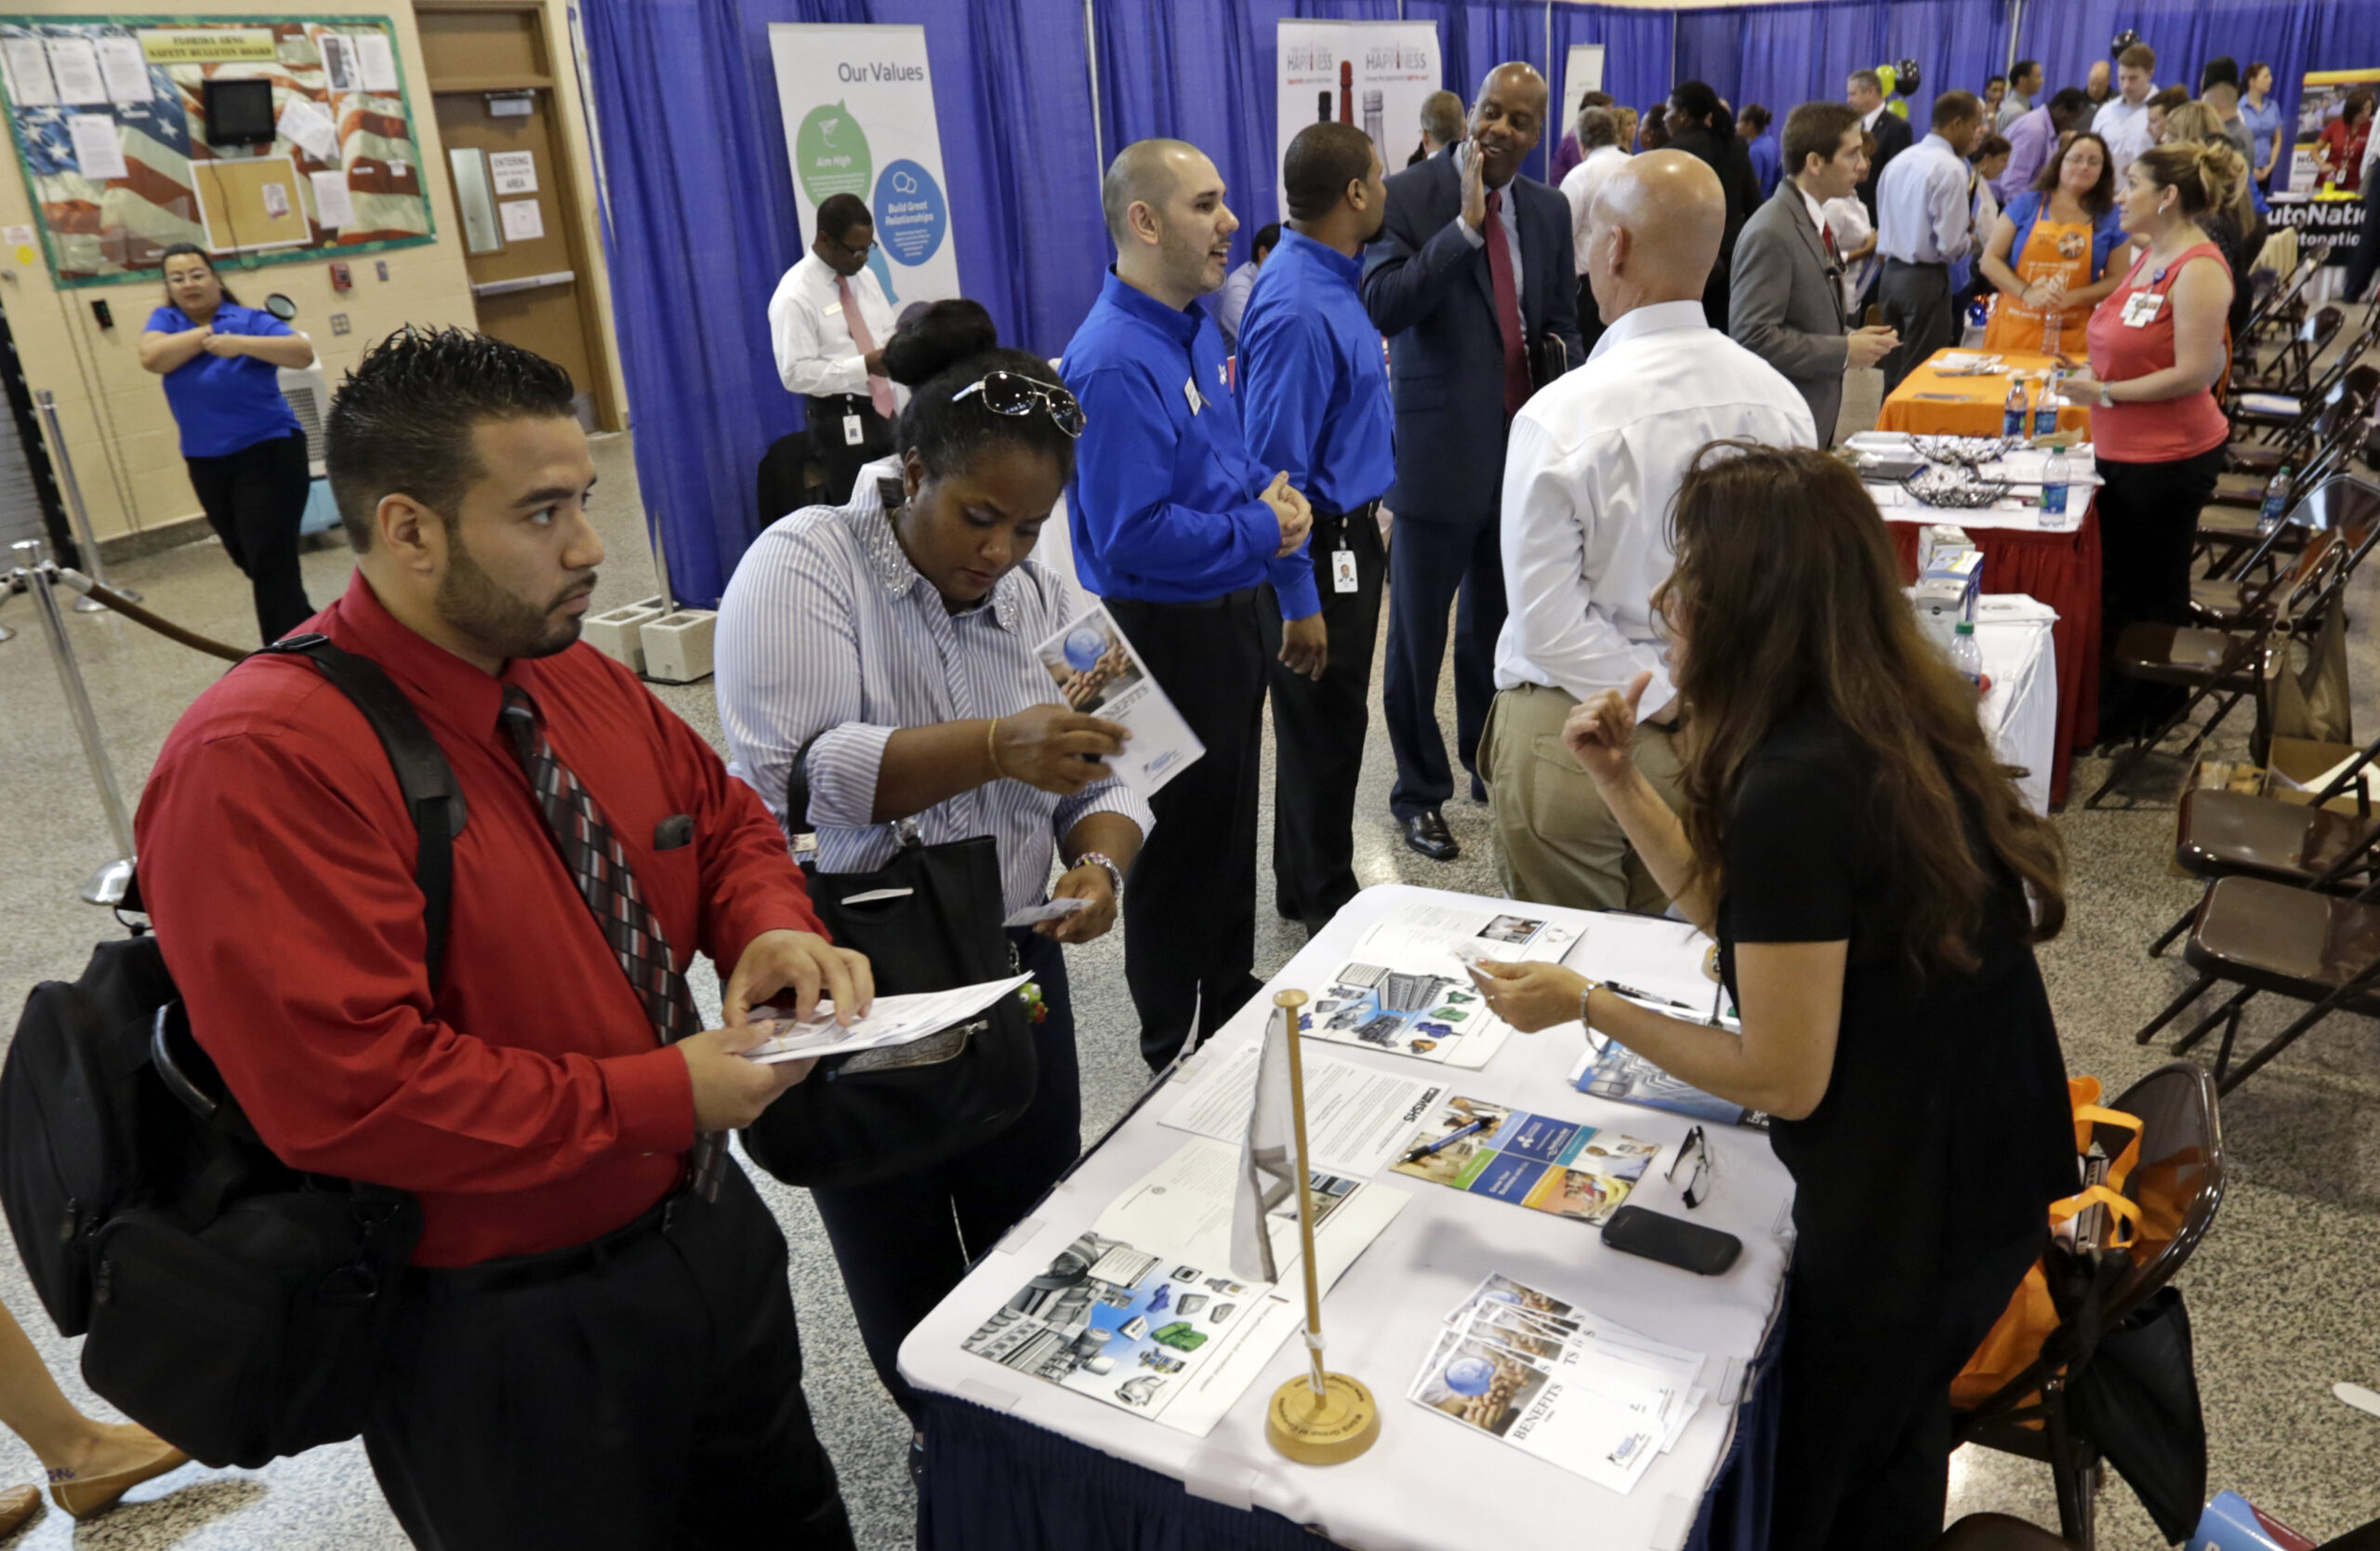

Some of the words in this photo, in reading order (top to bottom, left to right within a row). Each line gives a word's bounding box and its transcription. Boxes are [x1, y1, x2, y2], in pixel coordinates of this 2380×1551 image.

[150, 48, 186, 58] SAFETY
[190, 47, 236, 57] BULLETIN
[240, 46, 271, 56] BOARD
[838, 62, 867, 82] Our
[870, 61, 923, 82] Values
[816, 156, 832, 166] Aim
[832, 155, 852, 168] High
[888, 202, 906, 214] Build
[907, 200, 928, 212] Great
[2267, 203, 2366, 225] utoNati
[885, 212, 934, 225] Relationships
[1513, 1383, 1564, 1440] BENEFITS
